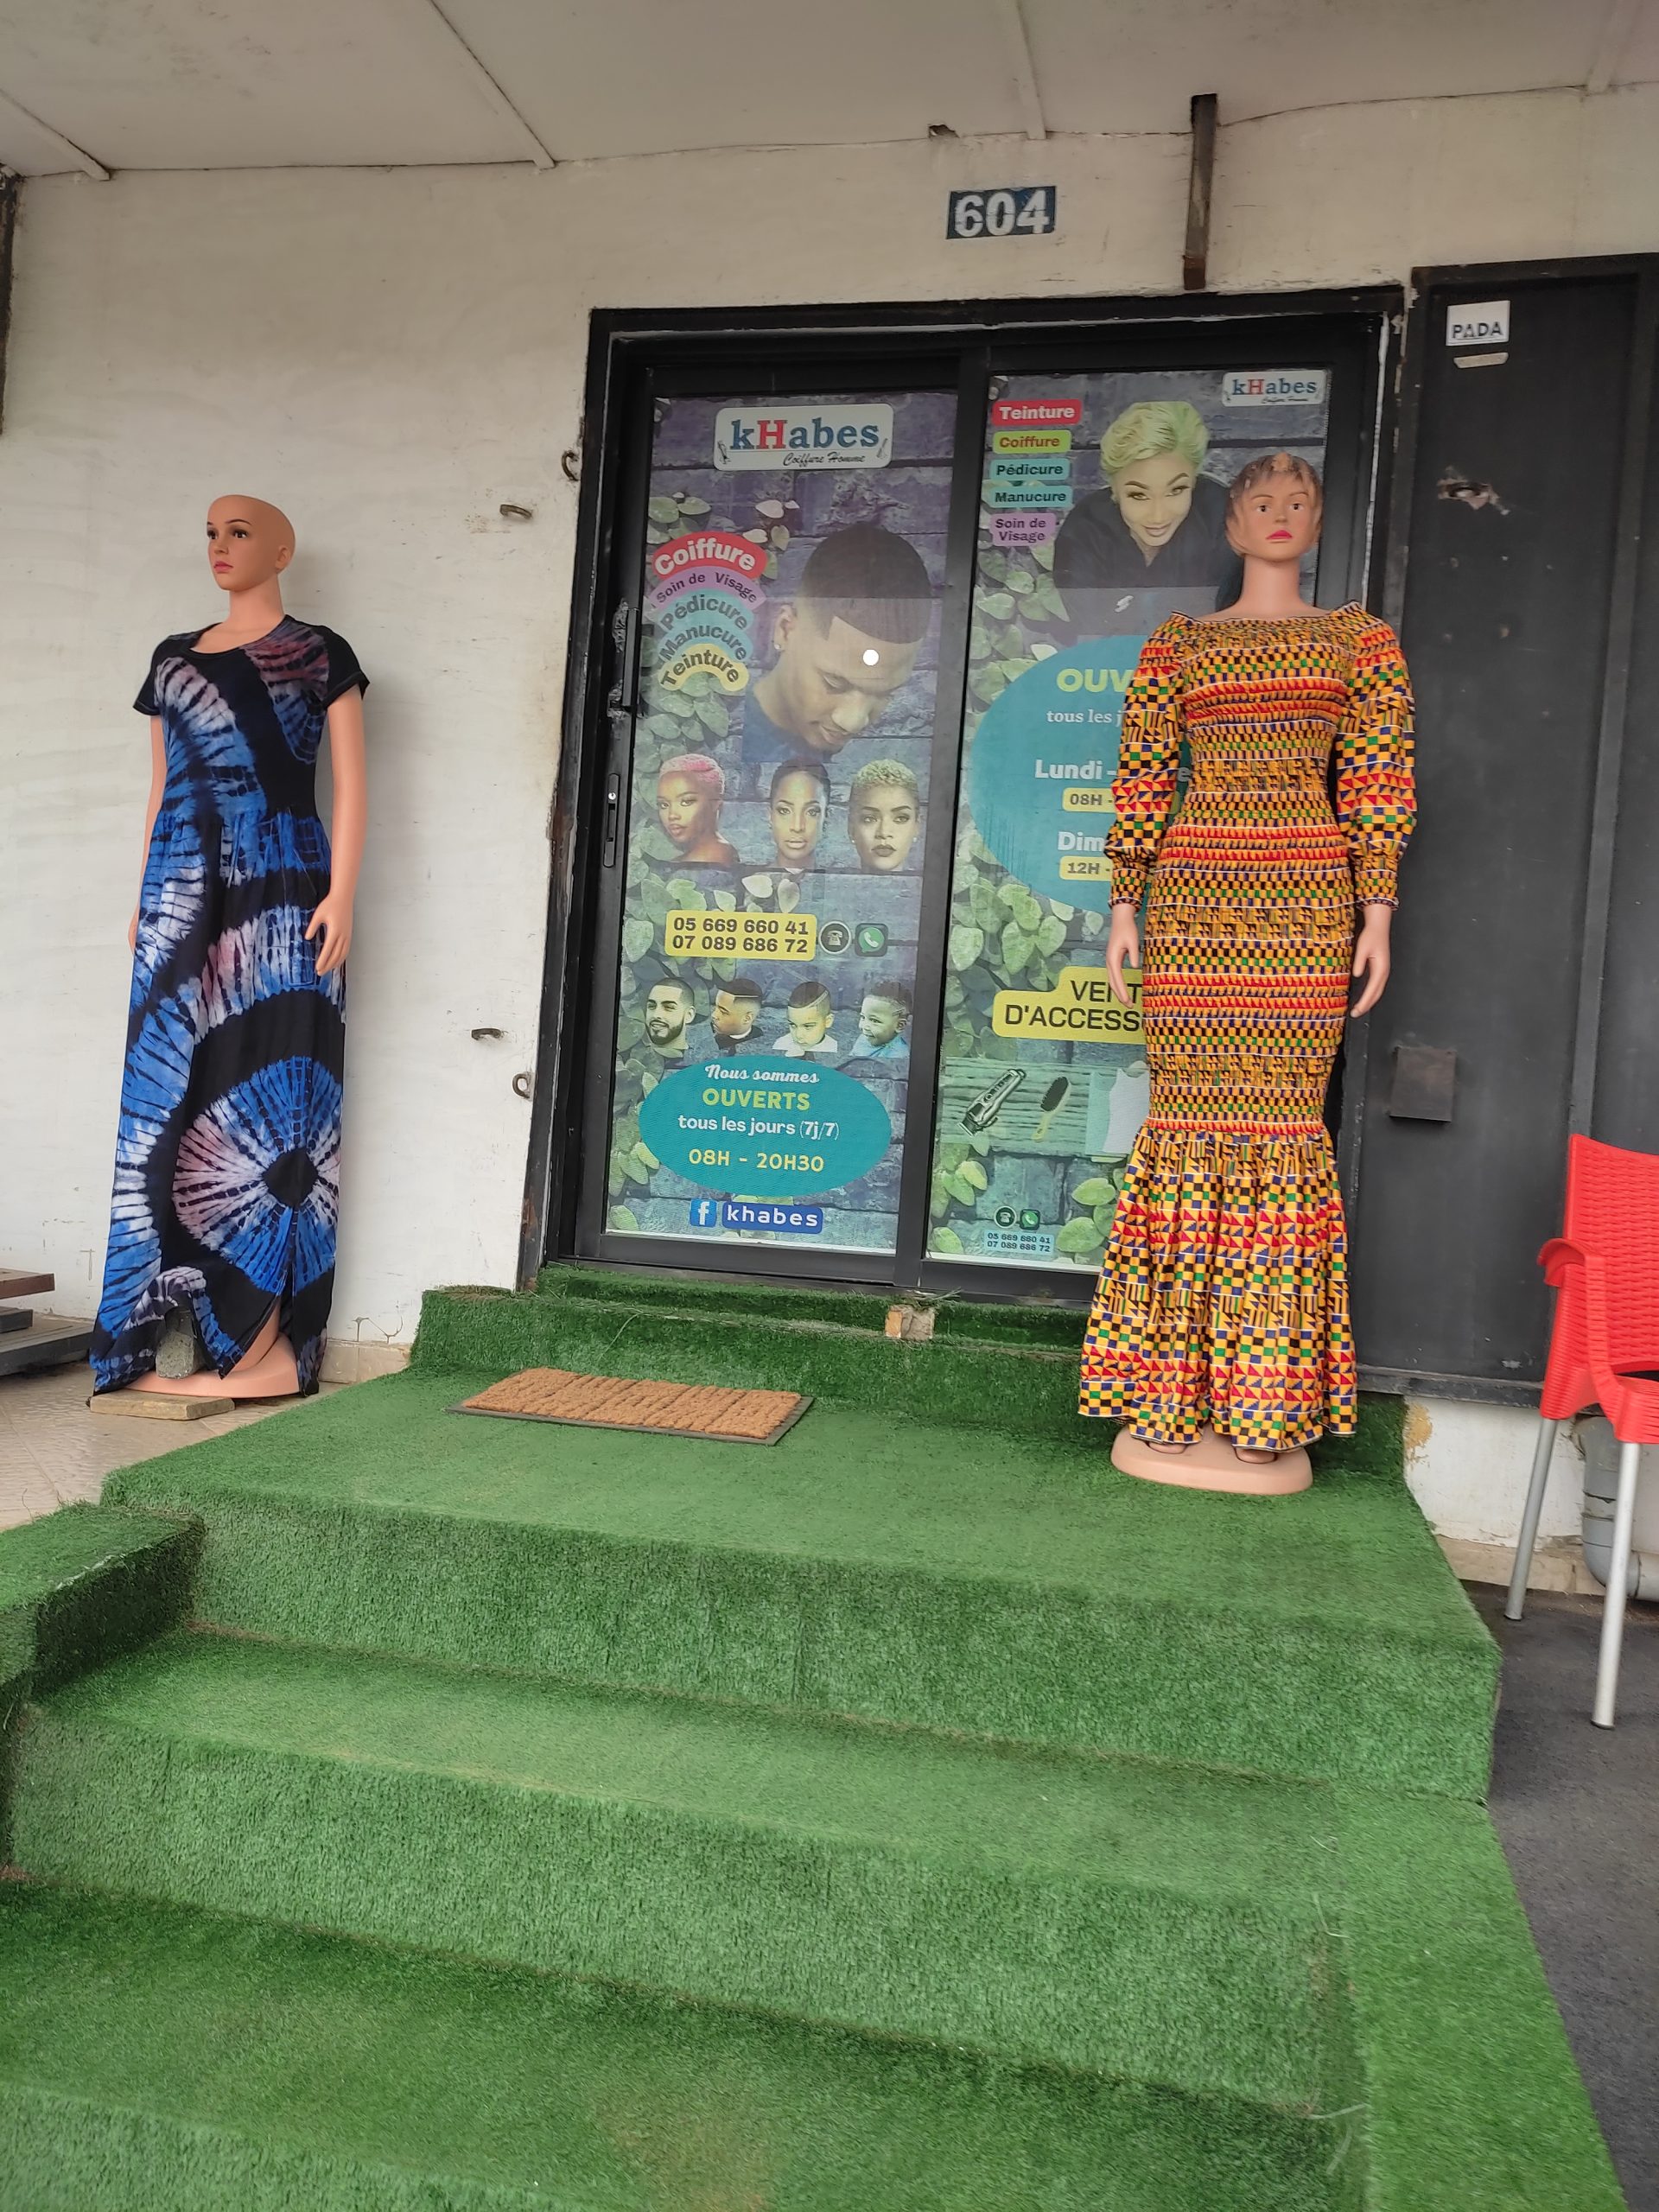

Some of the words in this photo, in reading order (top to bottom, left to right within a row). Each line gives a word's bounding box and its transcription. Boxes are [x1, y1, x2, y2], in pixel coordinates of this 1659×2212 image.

[955, 189, 1050, 238] 604
[1452, 321, 1503, 338] PADA
[1232, 378, 1317, 395] kHabes
[999, 406, 1075, 420] Teinture
[729, 416, 880, 449] kHabes
[1000, 435, 1060, 448] Coiffure
[996, 464, 1064, 475] Pédicure
[995, 492, 1066, 502] Manucure
[995, 518, 1025, 529] Soin
[1029, 518, 1046, 528] de
[999, 531, 1046, 543] Visage
[655, 537, 756, 575] Coiffure
[656, 580, 685, 603] Soin
[689, 573, 706, 585] de
[715, 571, 757, 603] Visage
[660, 594, 747, 631] Pédicure
[659, 625, 747, 662] Manucure
[660, 649, 739, 687] Teinture
[1046, 710, 1084, 723] tous
[1088, 709, 1112, 723] les
[1035, 759, 1103, 779] Lundi
[1070, 794, 1103, 805] 08H
[1067, 861, 1100, 874] 12H
[673, 917, 696, 931] 05
[702, 918, 737, 933] 669
[744, 919, 779, 934] 660
[785, 920, 809, 935] 41
[672, 935, 696, 950] 07
[702, 936, 737, 950] 089
[743, 938, 778, 952] 686
[785, 938, 808, 953] 72
[705, 1064, 749, 1080] Nous
[753, 1071, 820, 1084] sommes
[702, 1088, 810, 1111] OUVERTS
[678, 1115, 718, 1130] tous
[721, 1116, 747, 1132] les
[747, 1119, 795, 1136] jours
[799, 1121, 840, 1141] (7j/7)
[689, 1148, 730, 1166] 08H
[757, 1153, 824, 1173] 20H30
[727, 1205, 818, 1227] khabes
